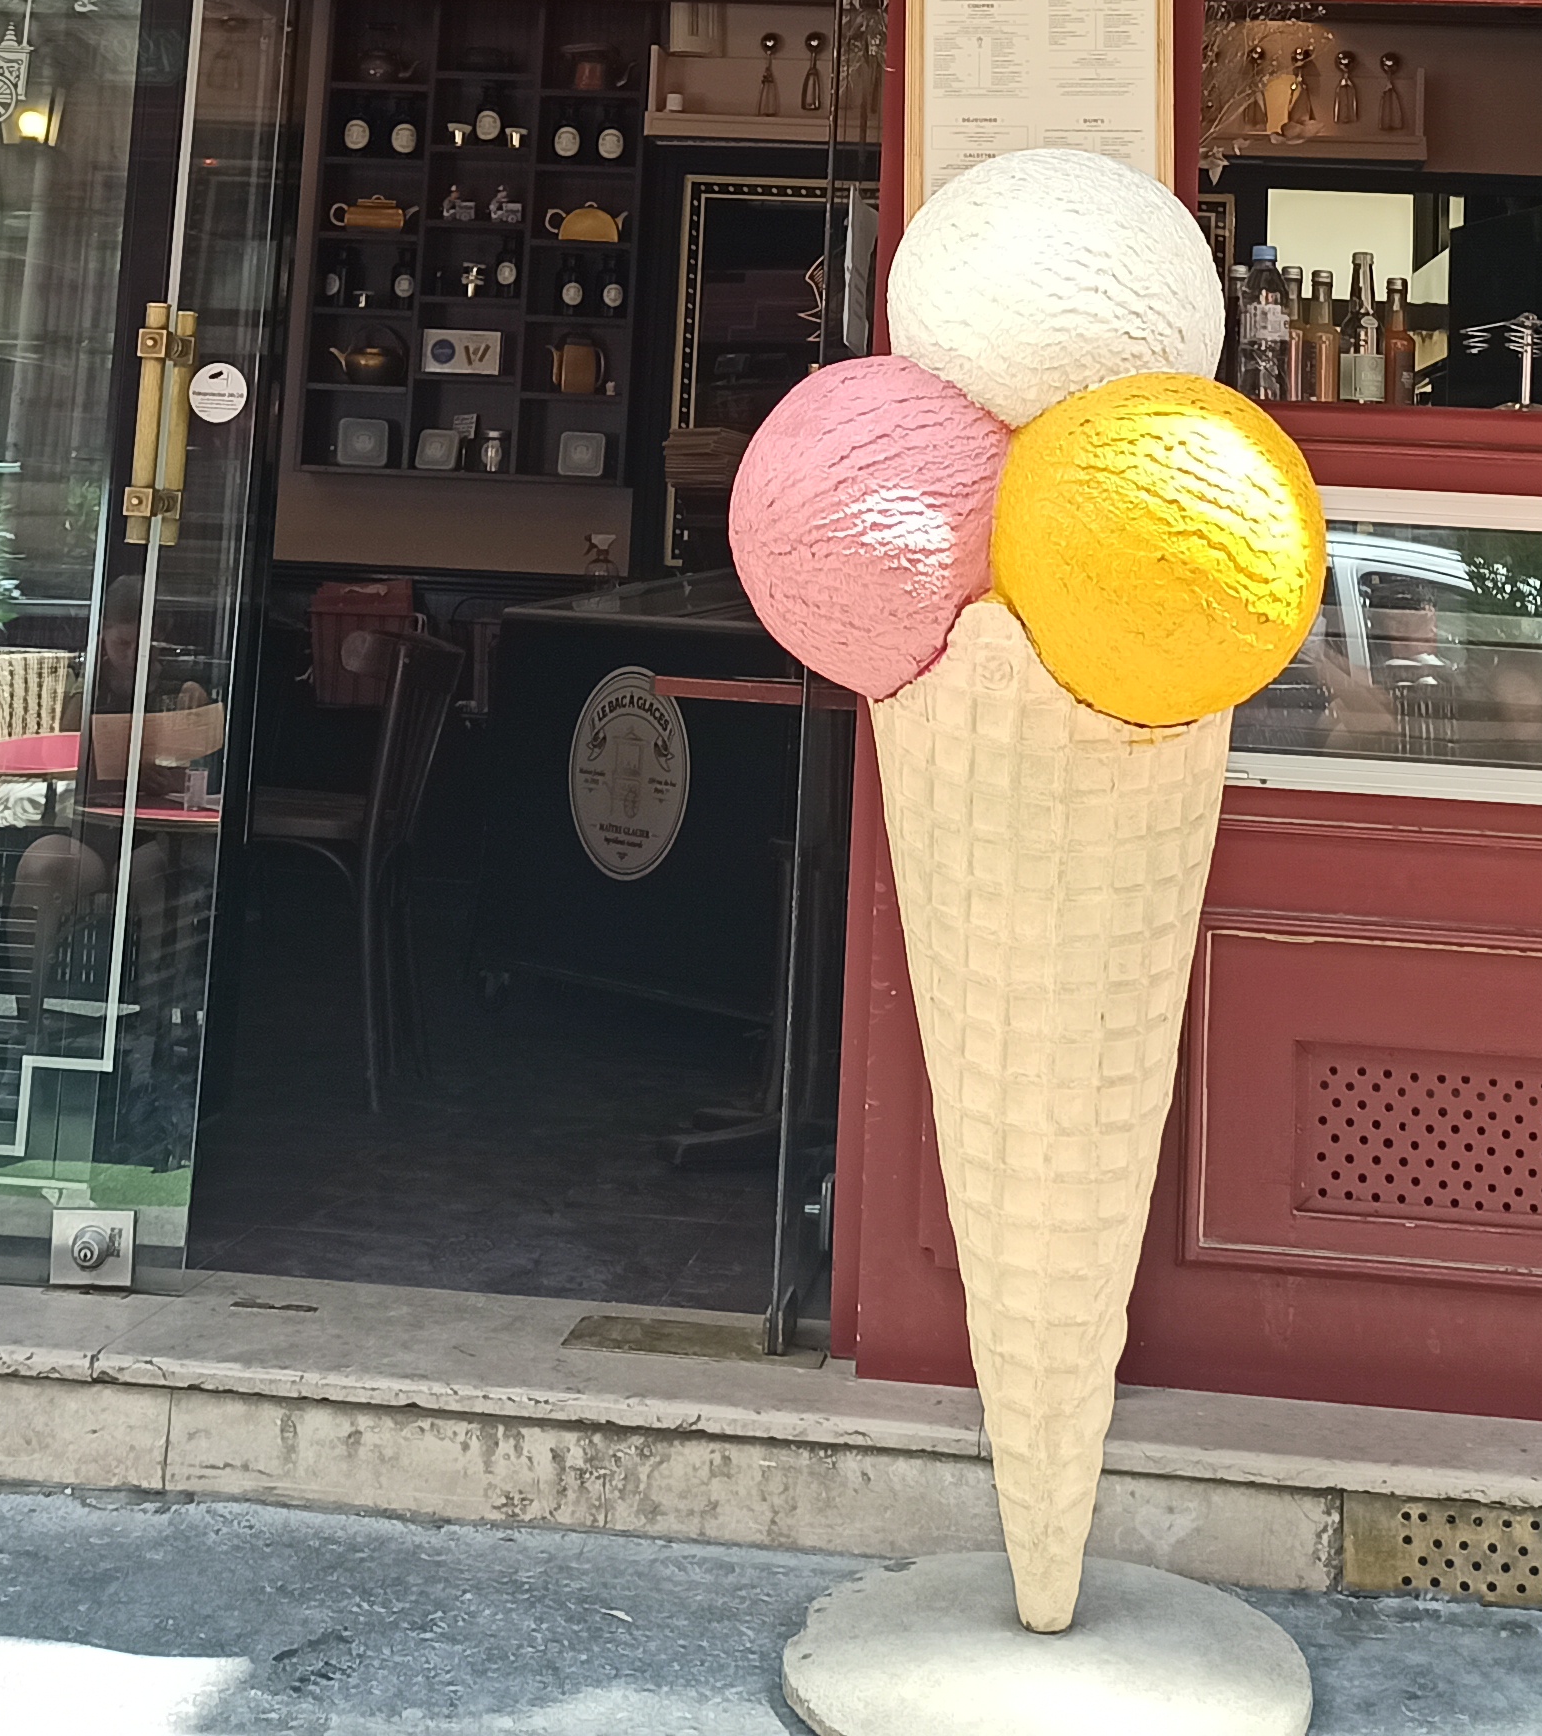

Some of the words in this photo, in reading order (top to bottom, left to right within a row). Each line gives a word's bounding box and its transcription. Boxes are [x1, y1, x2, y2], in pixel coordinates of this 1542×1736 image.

[597, 705, 608, 722] LE
[608, 695, 627, 713] BAC
[637, 696, 669, 732] GLACES
